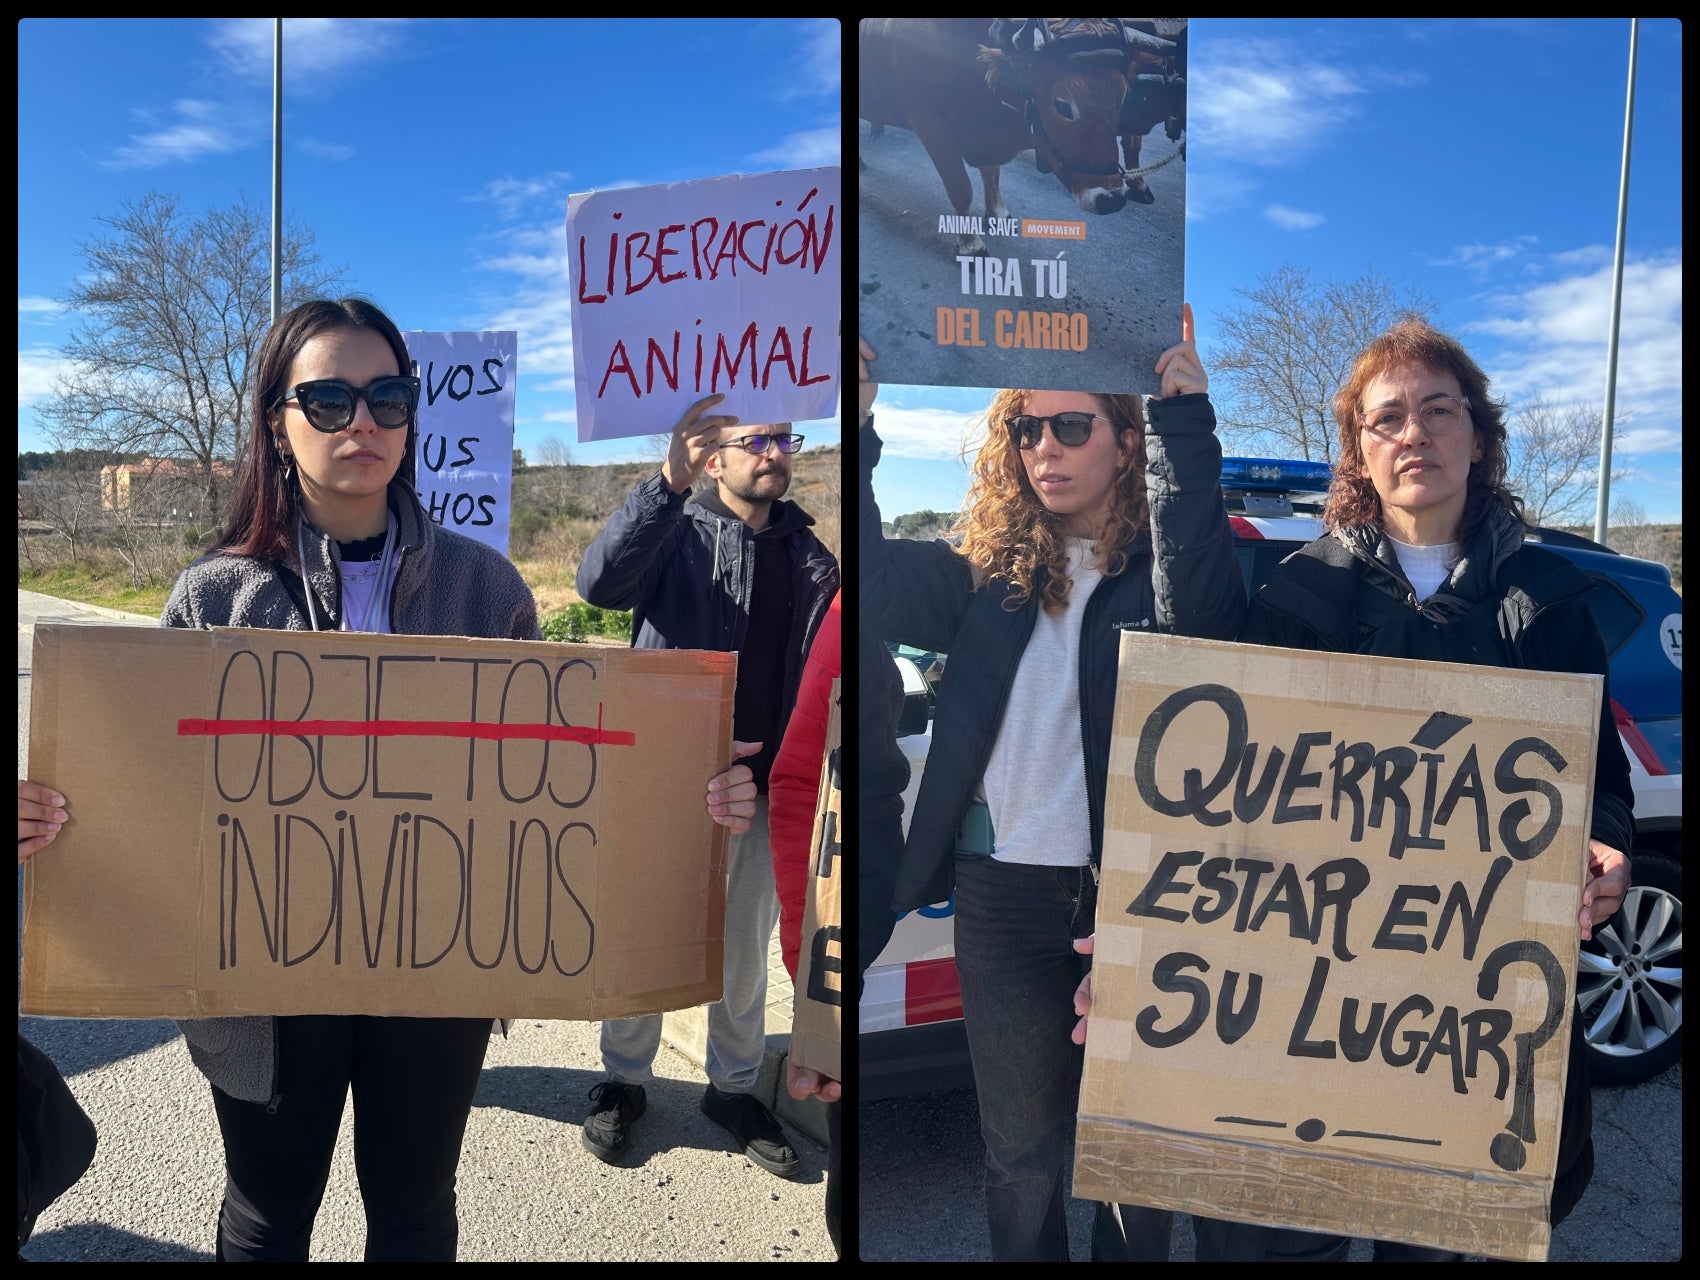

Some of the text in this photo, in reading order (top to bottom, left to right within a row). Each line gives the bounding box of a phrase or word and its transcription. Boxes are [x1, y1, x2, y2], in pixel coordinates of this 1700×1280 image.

[938, 214, 1081, 238] ANIMAL SAVE MOVEMENT
[956, 251, 1067, 300] TIRA TÚ
[936, 307, 1089, 352] DEL CARRO
[418, 493, 496, 526] HOS
[214, 650, 598, 810] OBJETOS
[1134, 683, 1568, 861] QUERRÍAS
[1126, 851, 1513, 962] ESTAR EN
[1135, 939, 1567, 1172] SU LUGAR?
